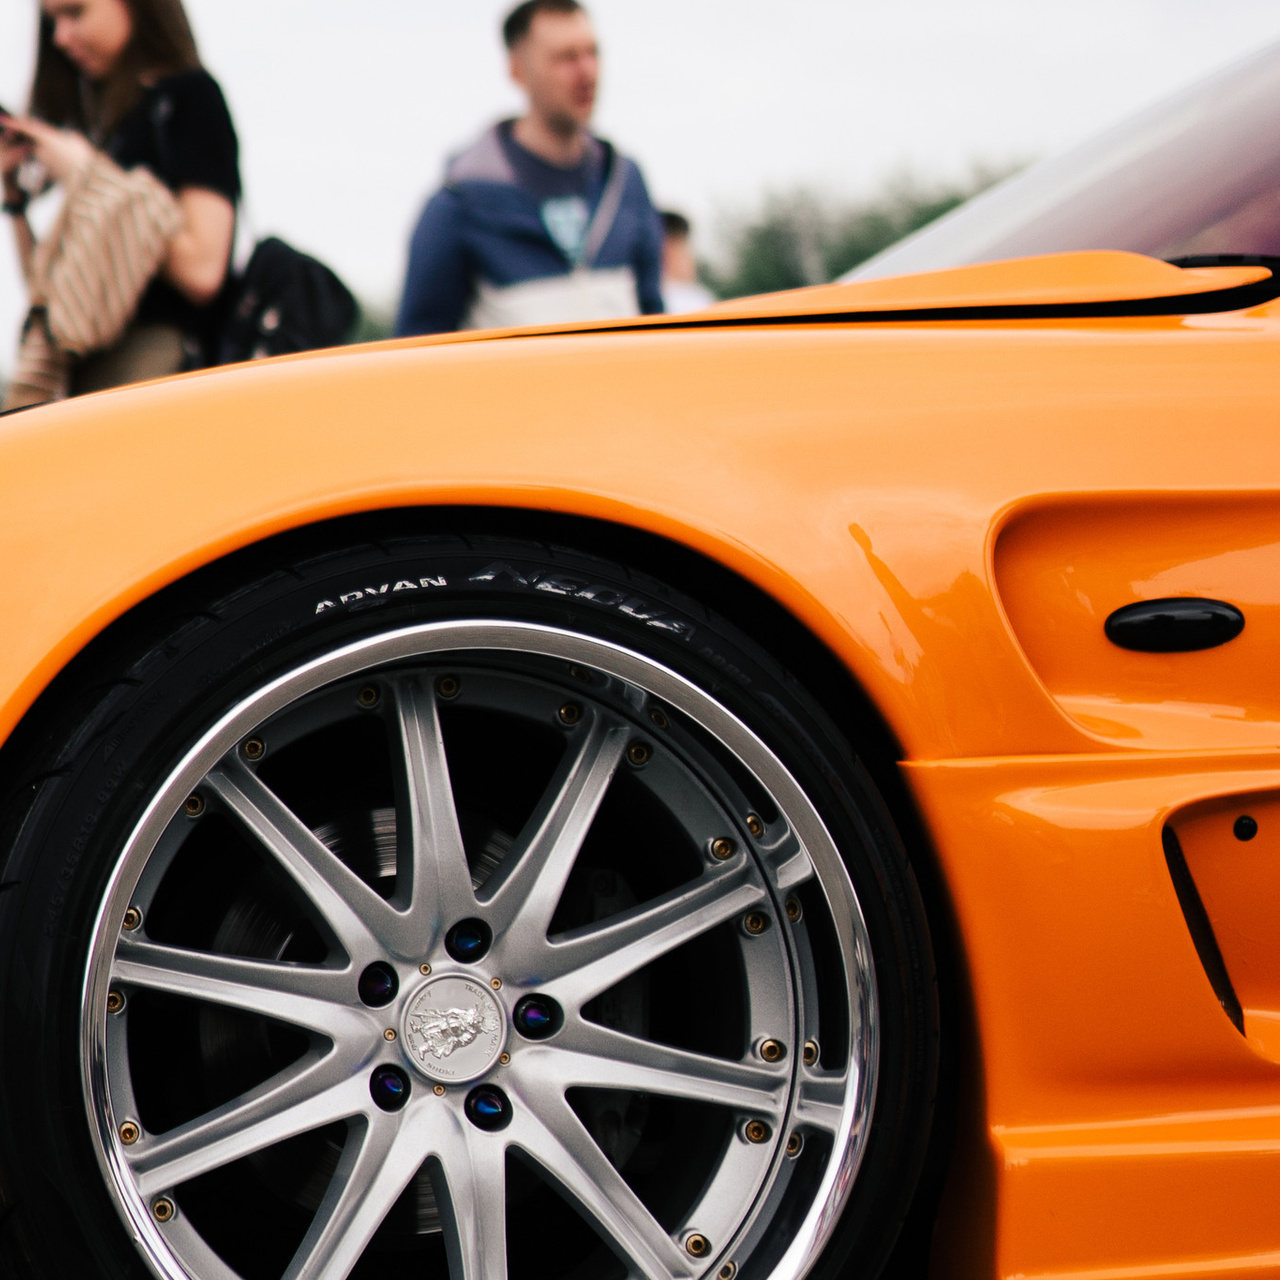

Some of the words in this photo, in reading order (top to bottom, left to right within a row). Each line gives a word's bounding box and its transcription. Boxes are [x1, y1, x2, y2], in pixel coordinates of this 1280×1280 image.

[314, 574, 448, 615] ADVAN
[464, 982, 487, 1000] TRADE
[484, 1034, 499, 1057] MARK
